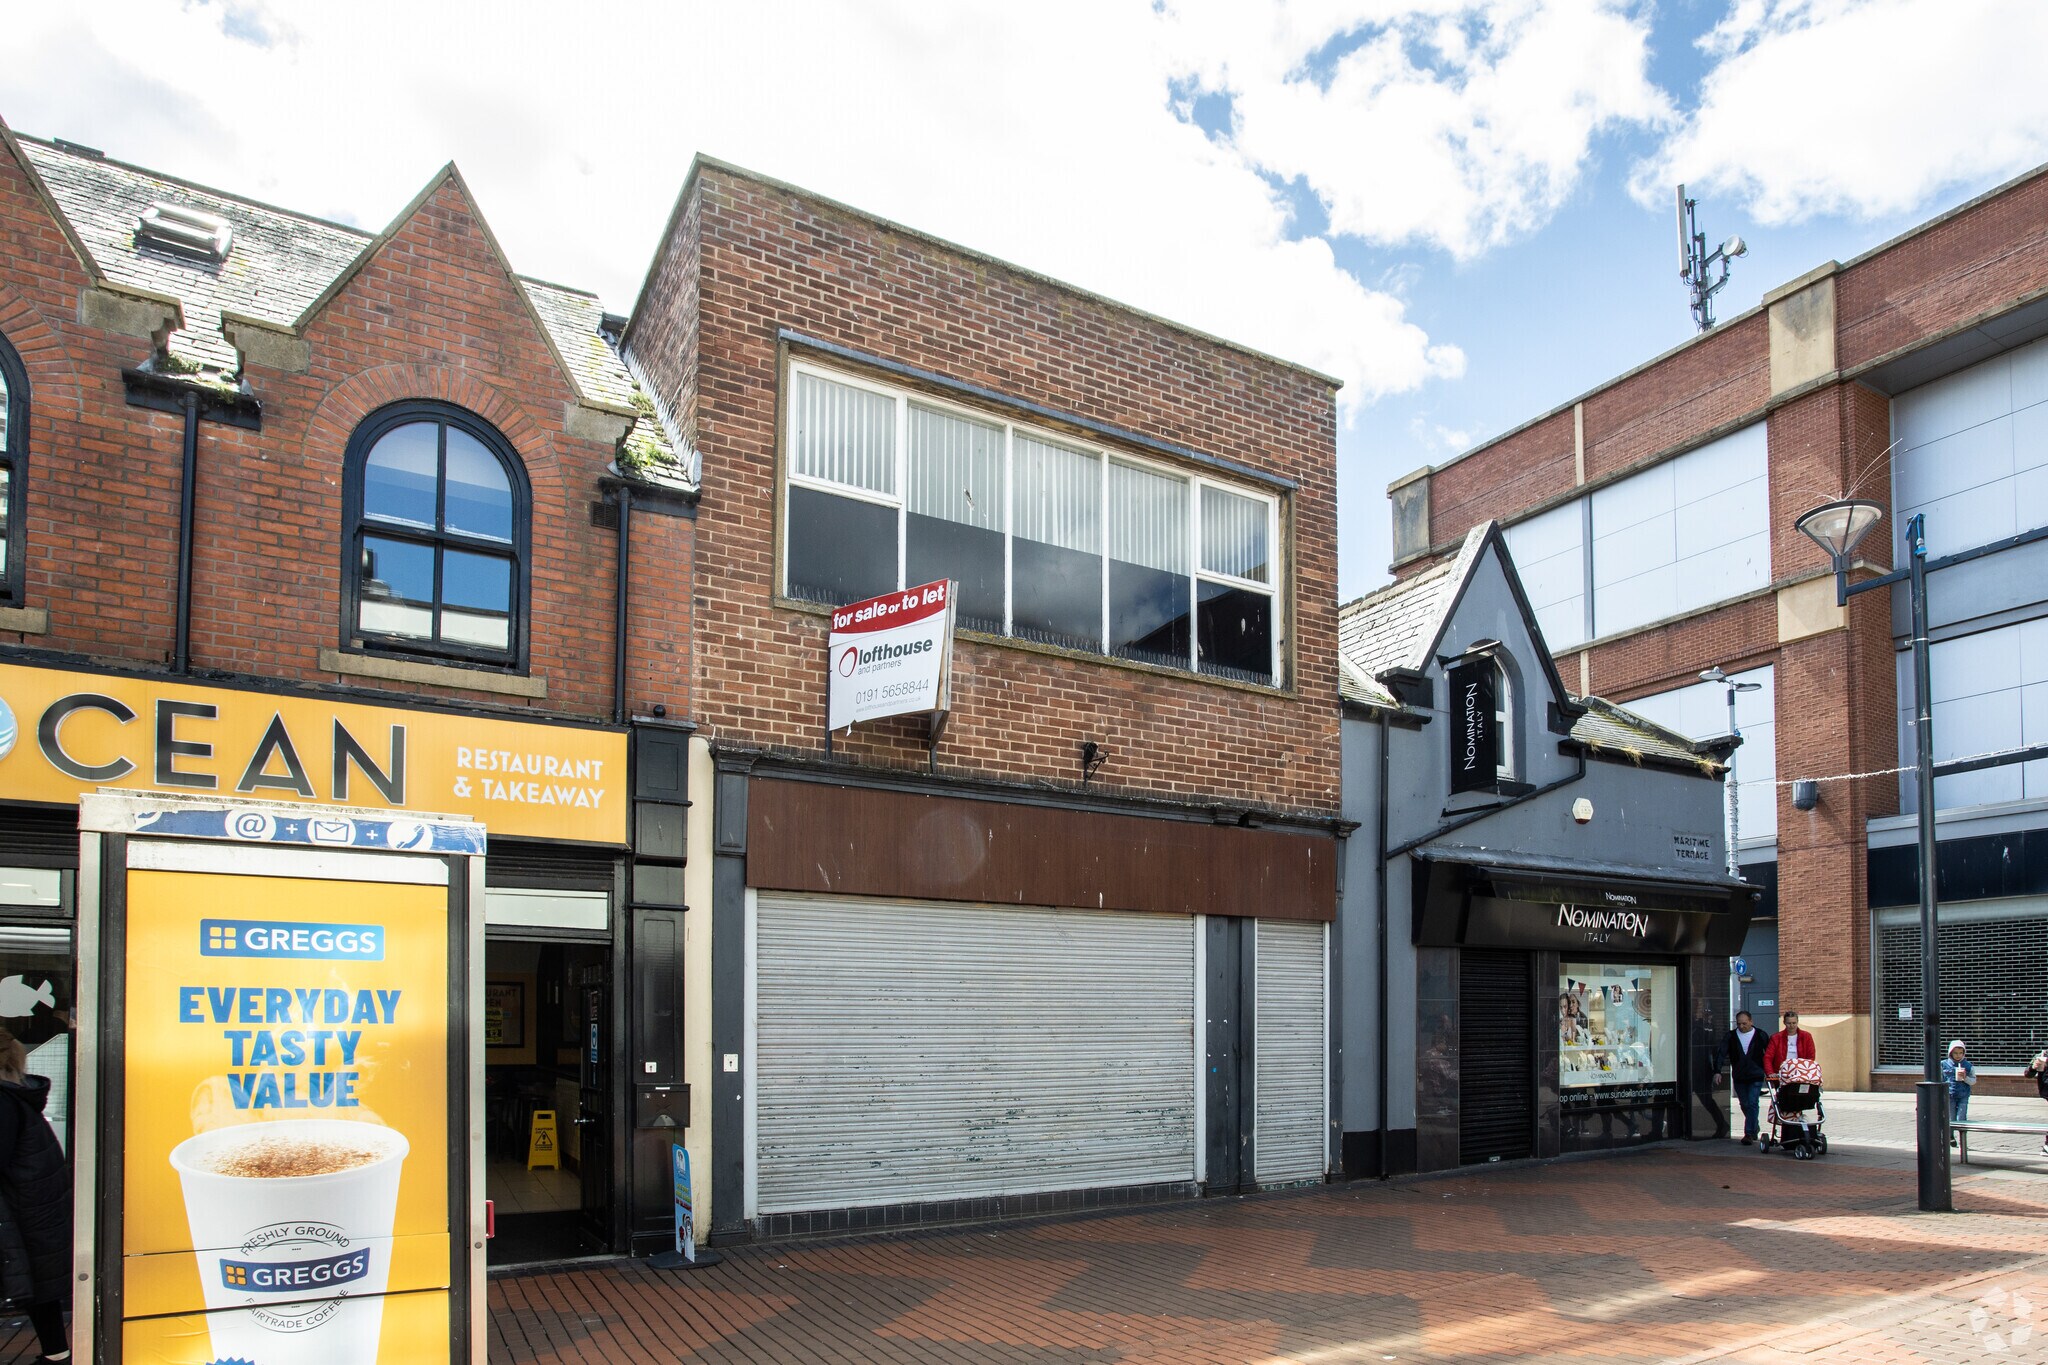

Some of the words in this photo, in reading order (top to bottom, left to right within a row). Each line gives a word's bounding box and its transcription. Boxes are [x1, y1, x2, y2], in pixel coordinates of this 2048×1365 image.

[833, 612, 853, 629] for
[854, 602, 887, 623] sale
[888, 603, 901, 614] or
[902, 594, 918, 610] to
[922, 585, 945, 604] let
[859, 638, 932, 665] lofthouse
[858, 665, 871, 675] and
[872, 660, 902, 674] partners
[856, 688, 878, 705] 0191
[882, 679, 928, 699] 5658844
[1464, 682, 1478, 770] NOMINATION
[0, 692, 408, 806] CEAN
[457, 746, 603, 781] RESTAURANT
[453, 775, 472, 798] &
[481, 778, 605, 809] TAKEAWAY
[1673, 836, 1710, 848] MARITIME
[1676, 849, 1709, 860] TERRACE
[1605, 892, 1637, 904] NOMINATION
[1557, 903, 1649, 938] NOMINATION
[244, 927, 376, 954] GREGGS
[1583, 932, 1611, 943] ITALY
[179, 986, 402, 1024] EVERYDAY
[223, 1030, 362, 1067] TASTY
[226, 1072, 360, 1110] VALUE
[1569, 1093, 1588, 1102] online
[239, 1227, 290, 1256] FRESHLY
[294, 1226, 350, 1249] GROUND
[252, 1256, 364, 1286] GREGGS
[244, 1297, 303, 1328] FAIRTRADE
[306, 1289, 348, 1326] COFFEE
